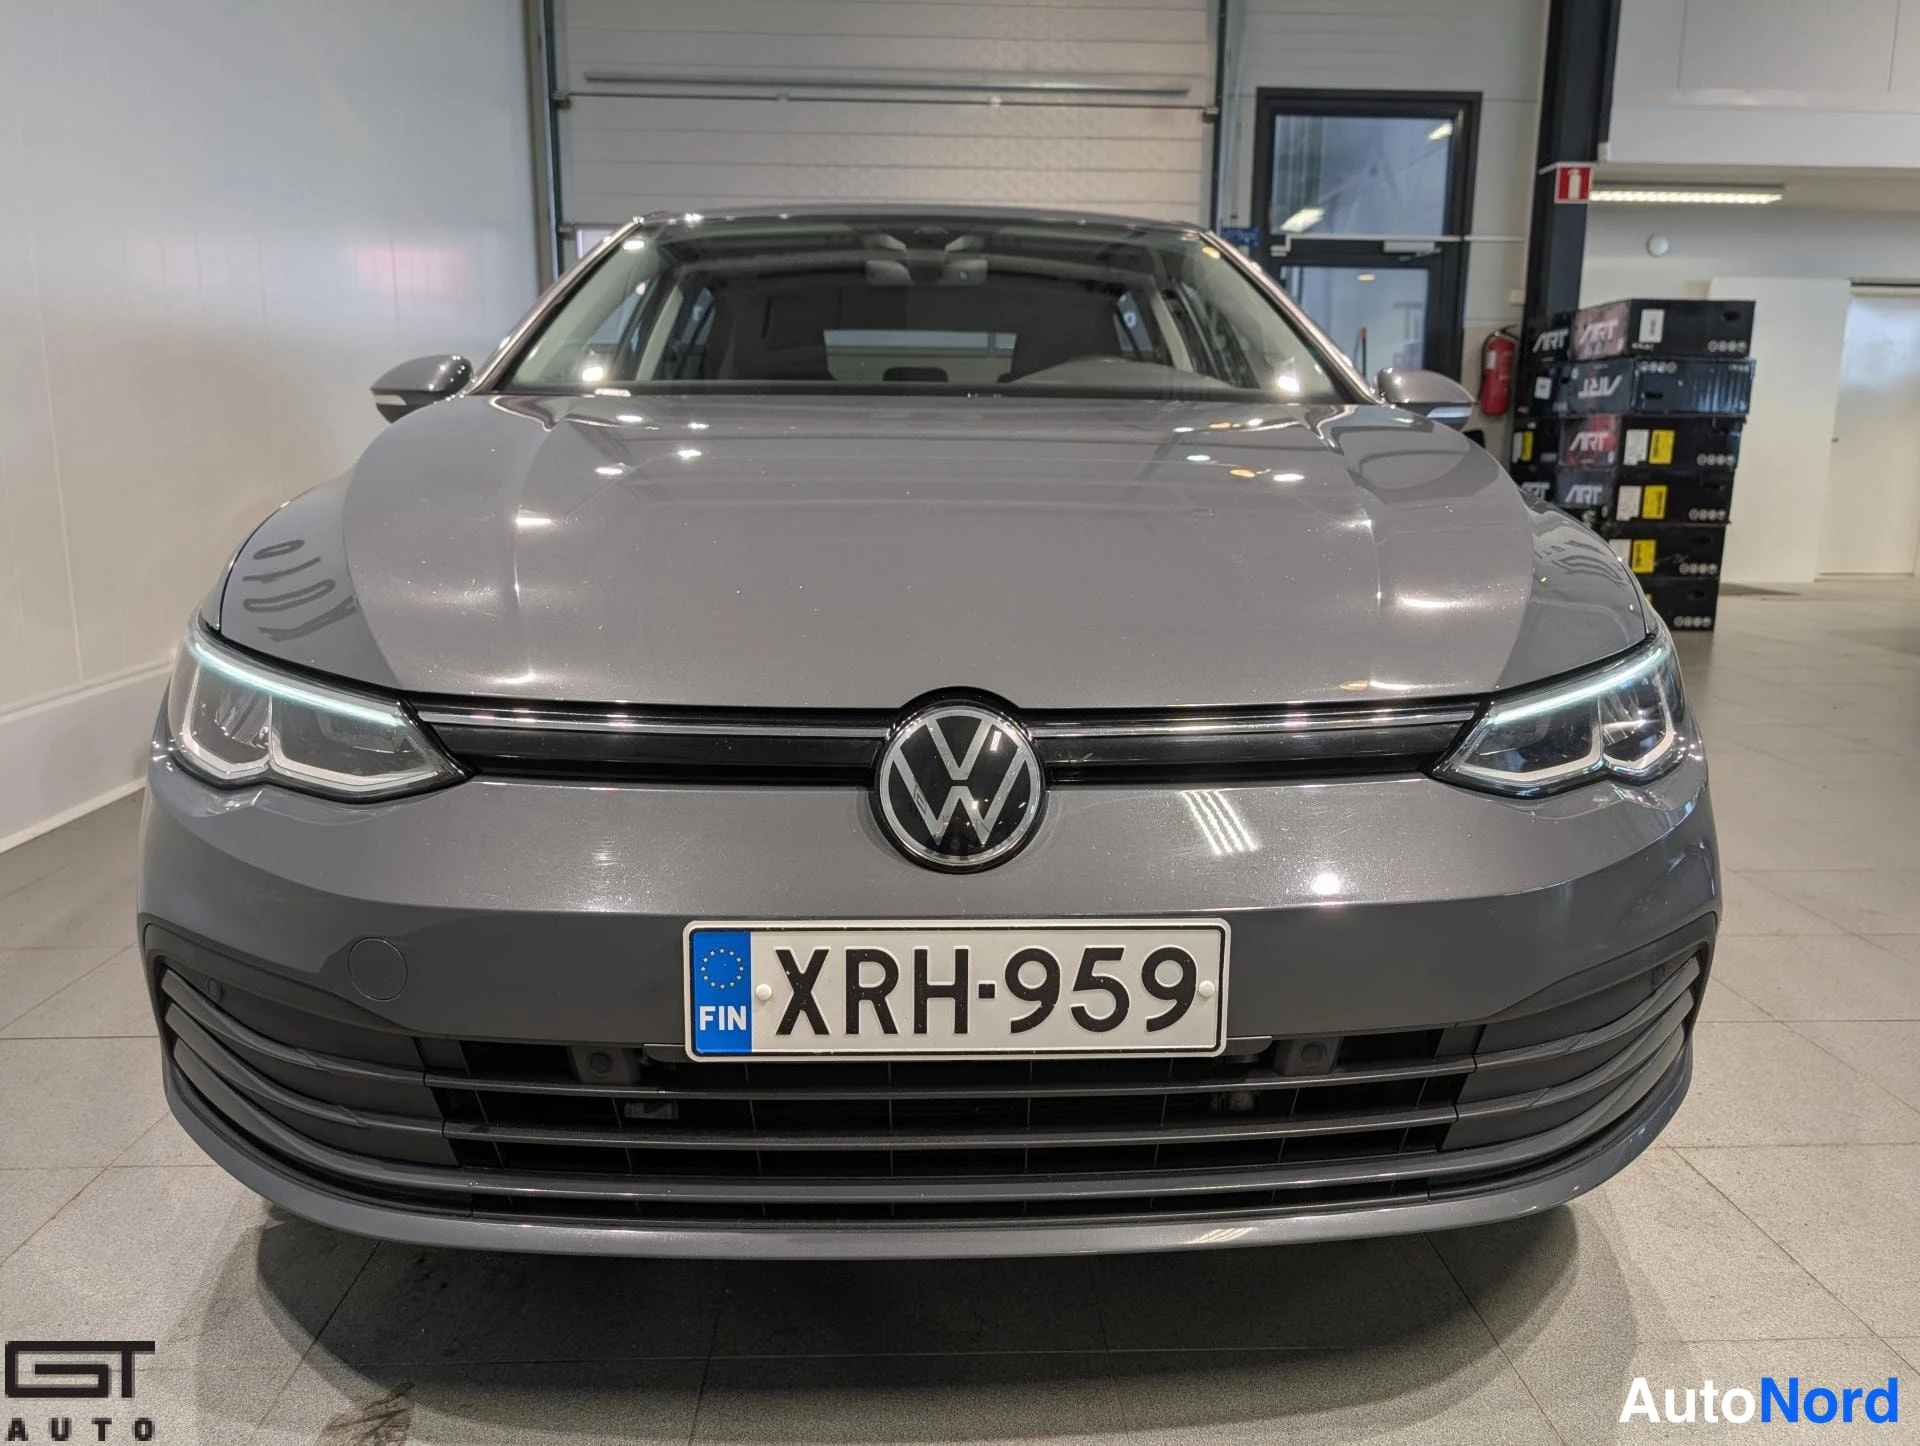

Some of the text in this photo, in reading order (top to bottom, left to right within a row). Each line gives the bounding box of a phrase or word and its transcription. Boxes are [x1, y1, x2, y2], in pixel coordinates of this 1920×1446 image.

[1532, 328, 1569, 353] ART
[1578, 320, 1618, 345] ART
[1577, 374, 1622, 399] ART
[1569, 431, 1609, 452] ART
[1564, 484, 1603, 505] ART
[887, 712, 1032, 848] VW
[773, 946, 1198, 1036] XRH-959
[699, 1005, 748, 1032] FIN
